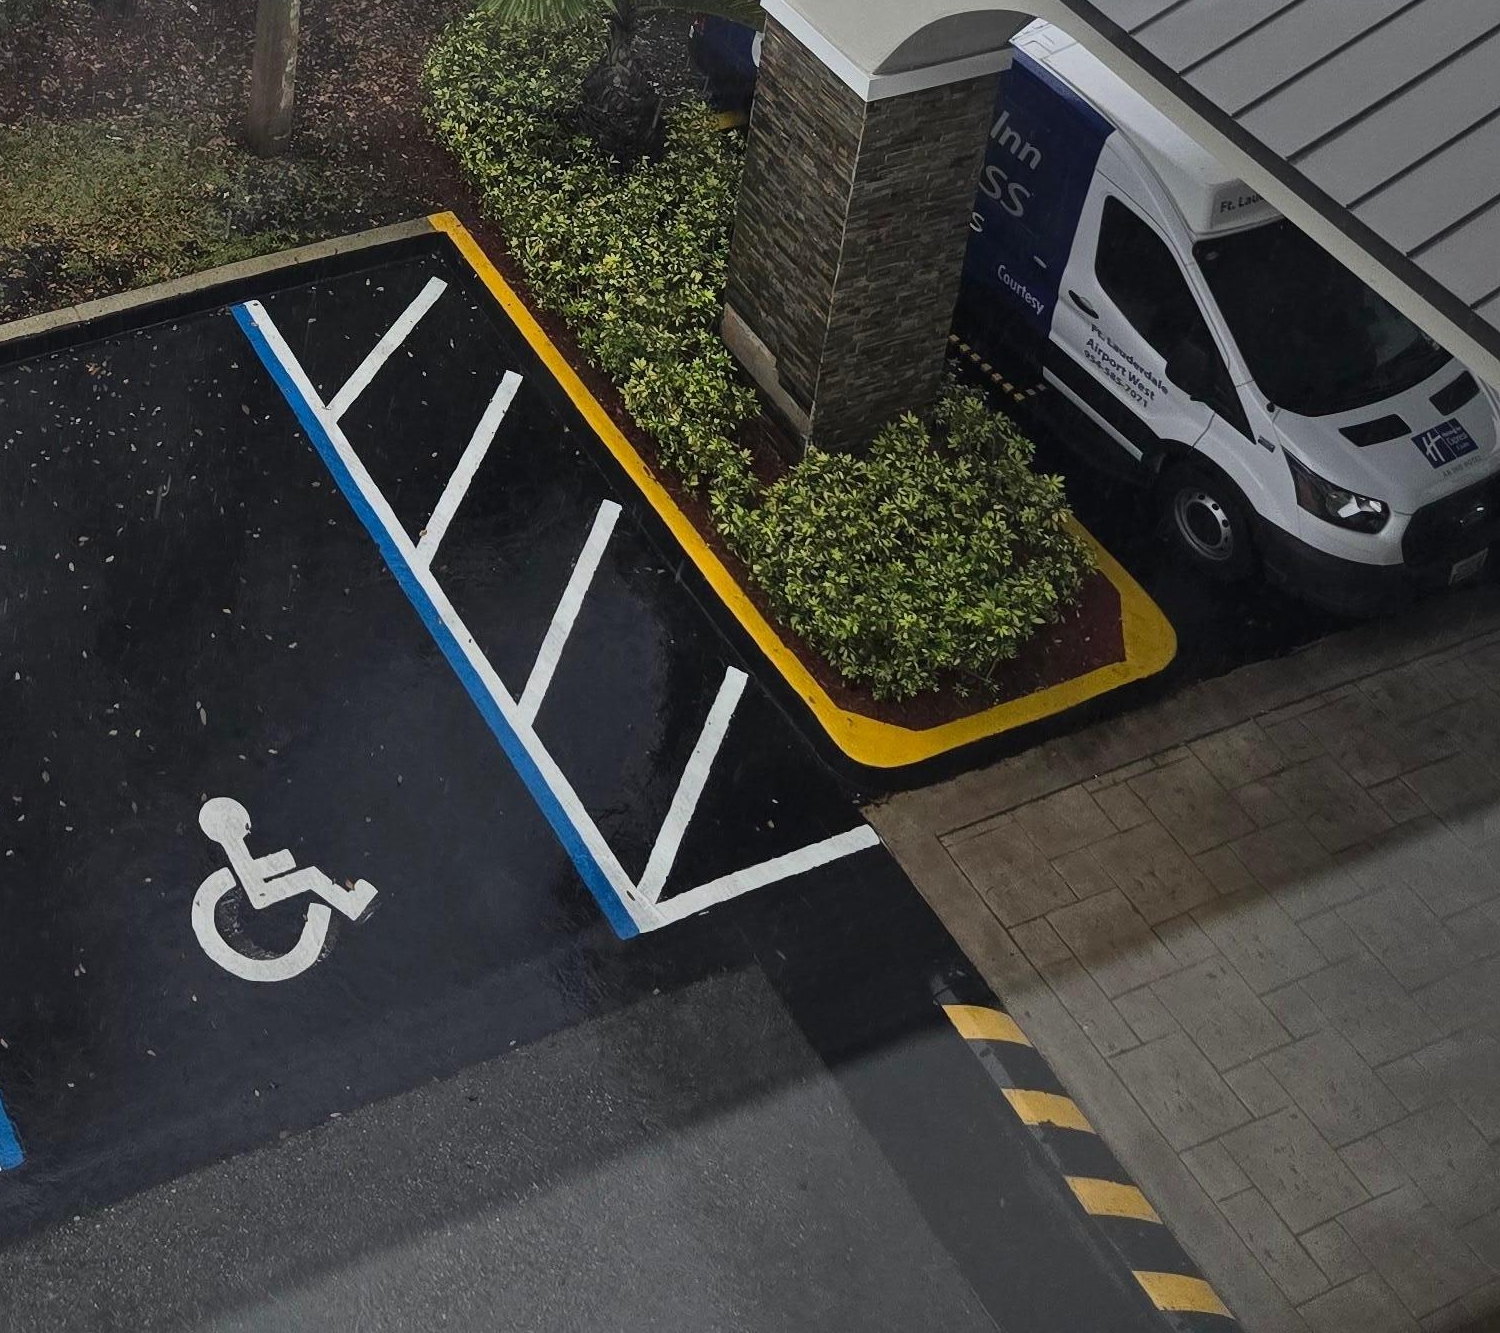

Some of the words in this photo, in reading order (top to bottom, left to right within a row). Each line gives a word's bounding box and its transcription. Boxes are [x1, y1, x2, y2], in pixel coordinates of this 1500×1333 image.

[990, 110, 1042, 170] Inn
[997, 264, 1045, 316] Courtesy
[1086, 338, 1127, 377] Airport
[1128, 371, 1155, 401] West
[1106, 337, 1168, 395] Lauderdale
